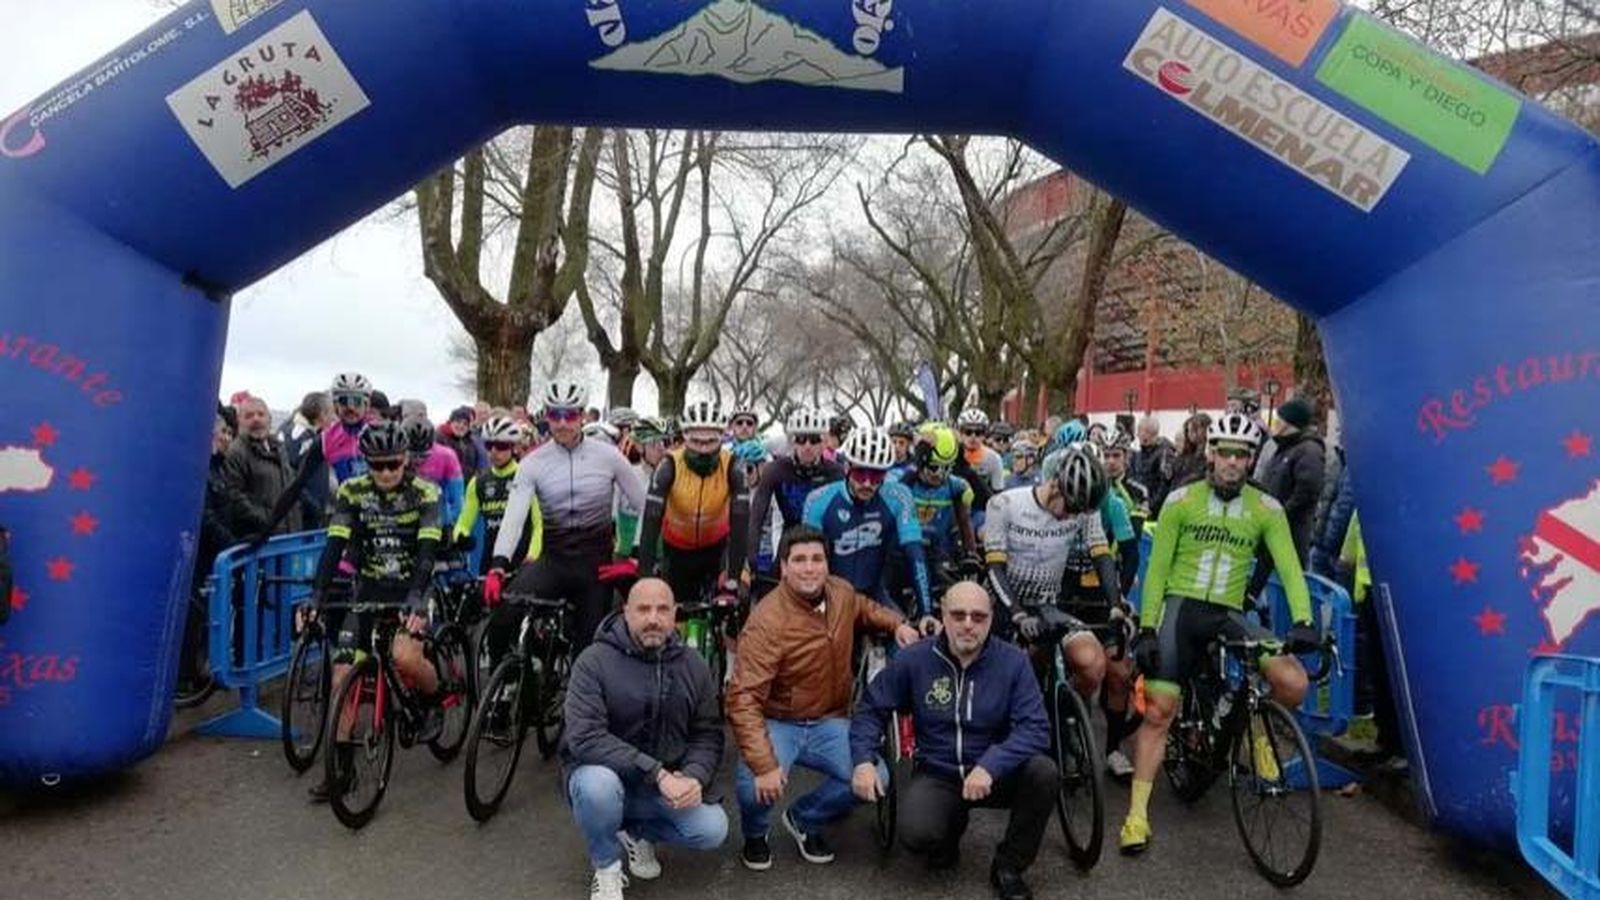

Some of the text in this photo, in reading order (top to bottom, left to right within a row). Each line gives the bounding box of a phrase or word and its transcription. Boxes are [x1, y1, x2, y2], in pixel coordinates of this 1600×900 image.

[1243, 0, 1312, 38] VAS
[198, 42, 322, 128] LA GRUTA
[1149, 18, 1391, 179] AUTO ESCUELA
[1408, 74, 1421, 90] Y
[1423, 82, 1486, 128] DIEGO
[0, 330, 123, 408] rante
[1417, 350, 1600, 442] Restaur
